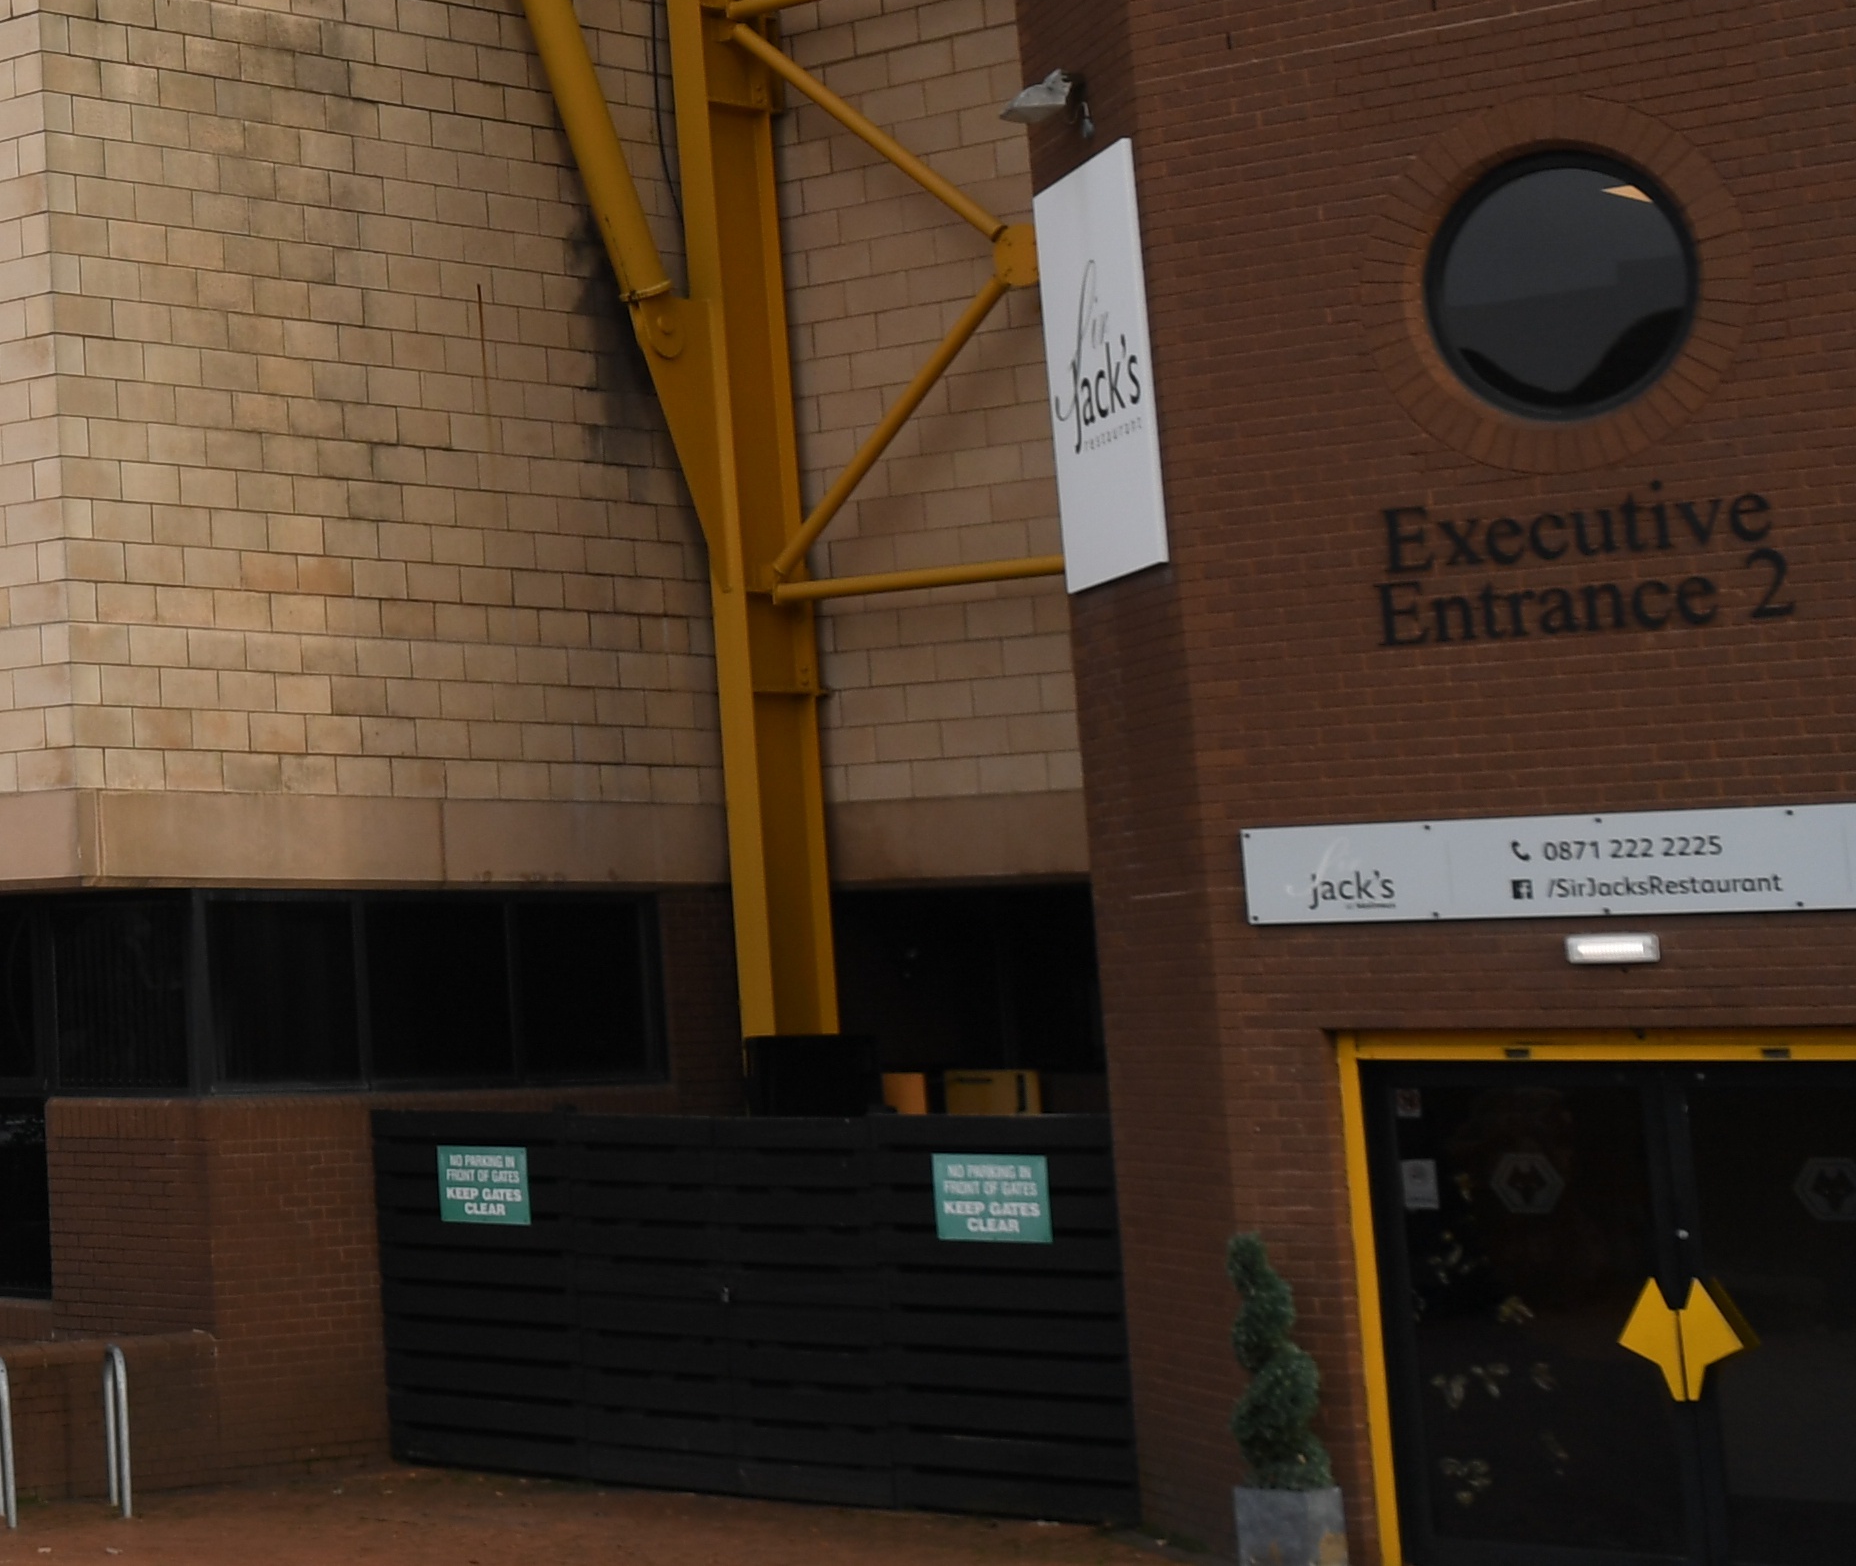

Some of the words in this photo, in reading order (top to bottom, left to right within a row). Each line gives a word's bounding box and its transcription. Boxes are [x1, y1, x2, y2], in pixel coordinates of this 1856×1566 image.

[1381, 480, 1773, 574] Executive
[1373, 573, 1719, 647] Entrance
[1746, 548, 1796, 619] 2
[1543, 841, 1601, 862] 0871
[1609, 838, 1654, 859] 222
[1661, 835, 1723, 858] 2225
[1308, 869, 1396, 910] jack's
[1547, 874, 1784, 898] /SirJacksRestaurant
[450, 1155, 463, 1166] NO
[464, 1155, 503, 1168] PARKING
[505, 1156, 515, 1168] IN
[446, 1168, 475, 1181] FRONT
[477, 1169, 489, 1182] OF
[491, 1170, 520, 1183] GATES
[947, 1164, 965, 1178] NO
[967, 1164, 1016, 1179] PARKING
[1018, 1165, 1032, 1179] IN
[446, 1187, 479, 1200] KEEP
[482, 1187, 522, 1202] GATES
[943, 1180, 980, 1195] FRONT
[983, 1181, 997, 1195] OF
[1001, 1181, 1038, 1196] GATES
[464, 1202, 506, 1215] CLEAR
[943, 1200, 985, 1215] KEEP
[989, 1201, 1041, 1217] GATES
[967, 1217, 1020, 1233] CLEAR
